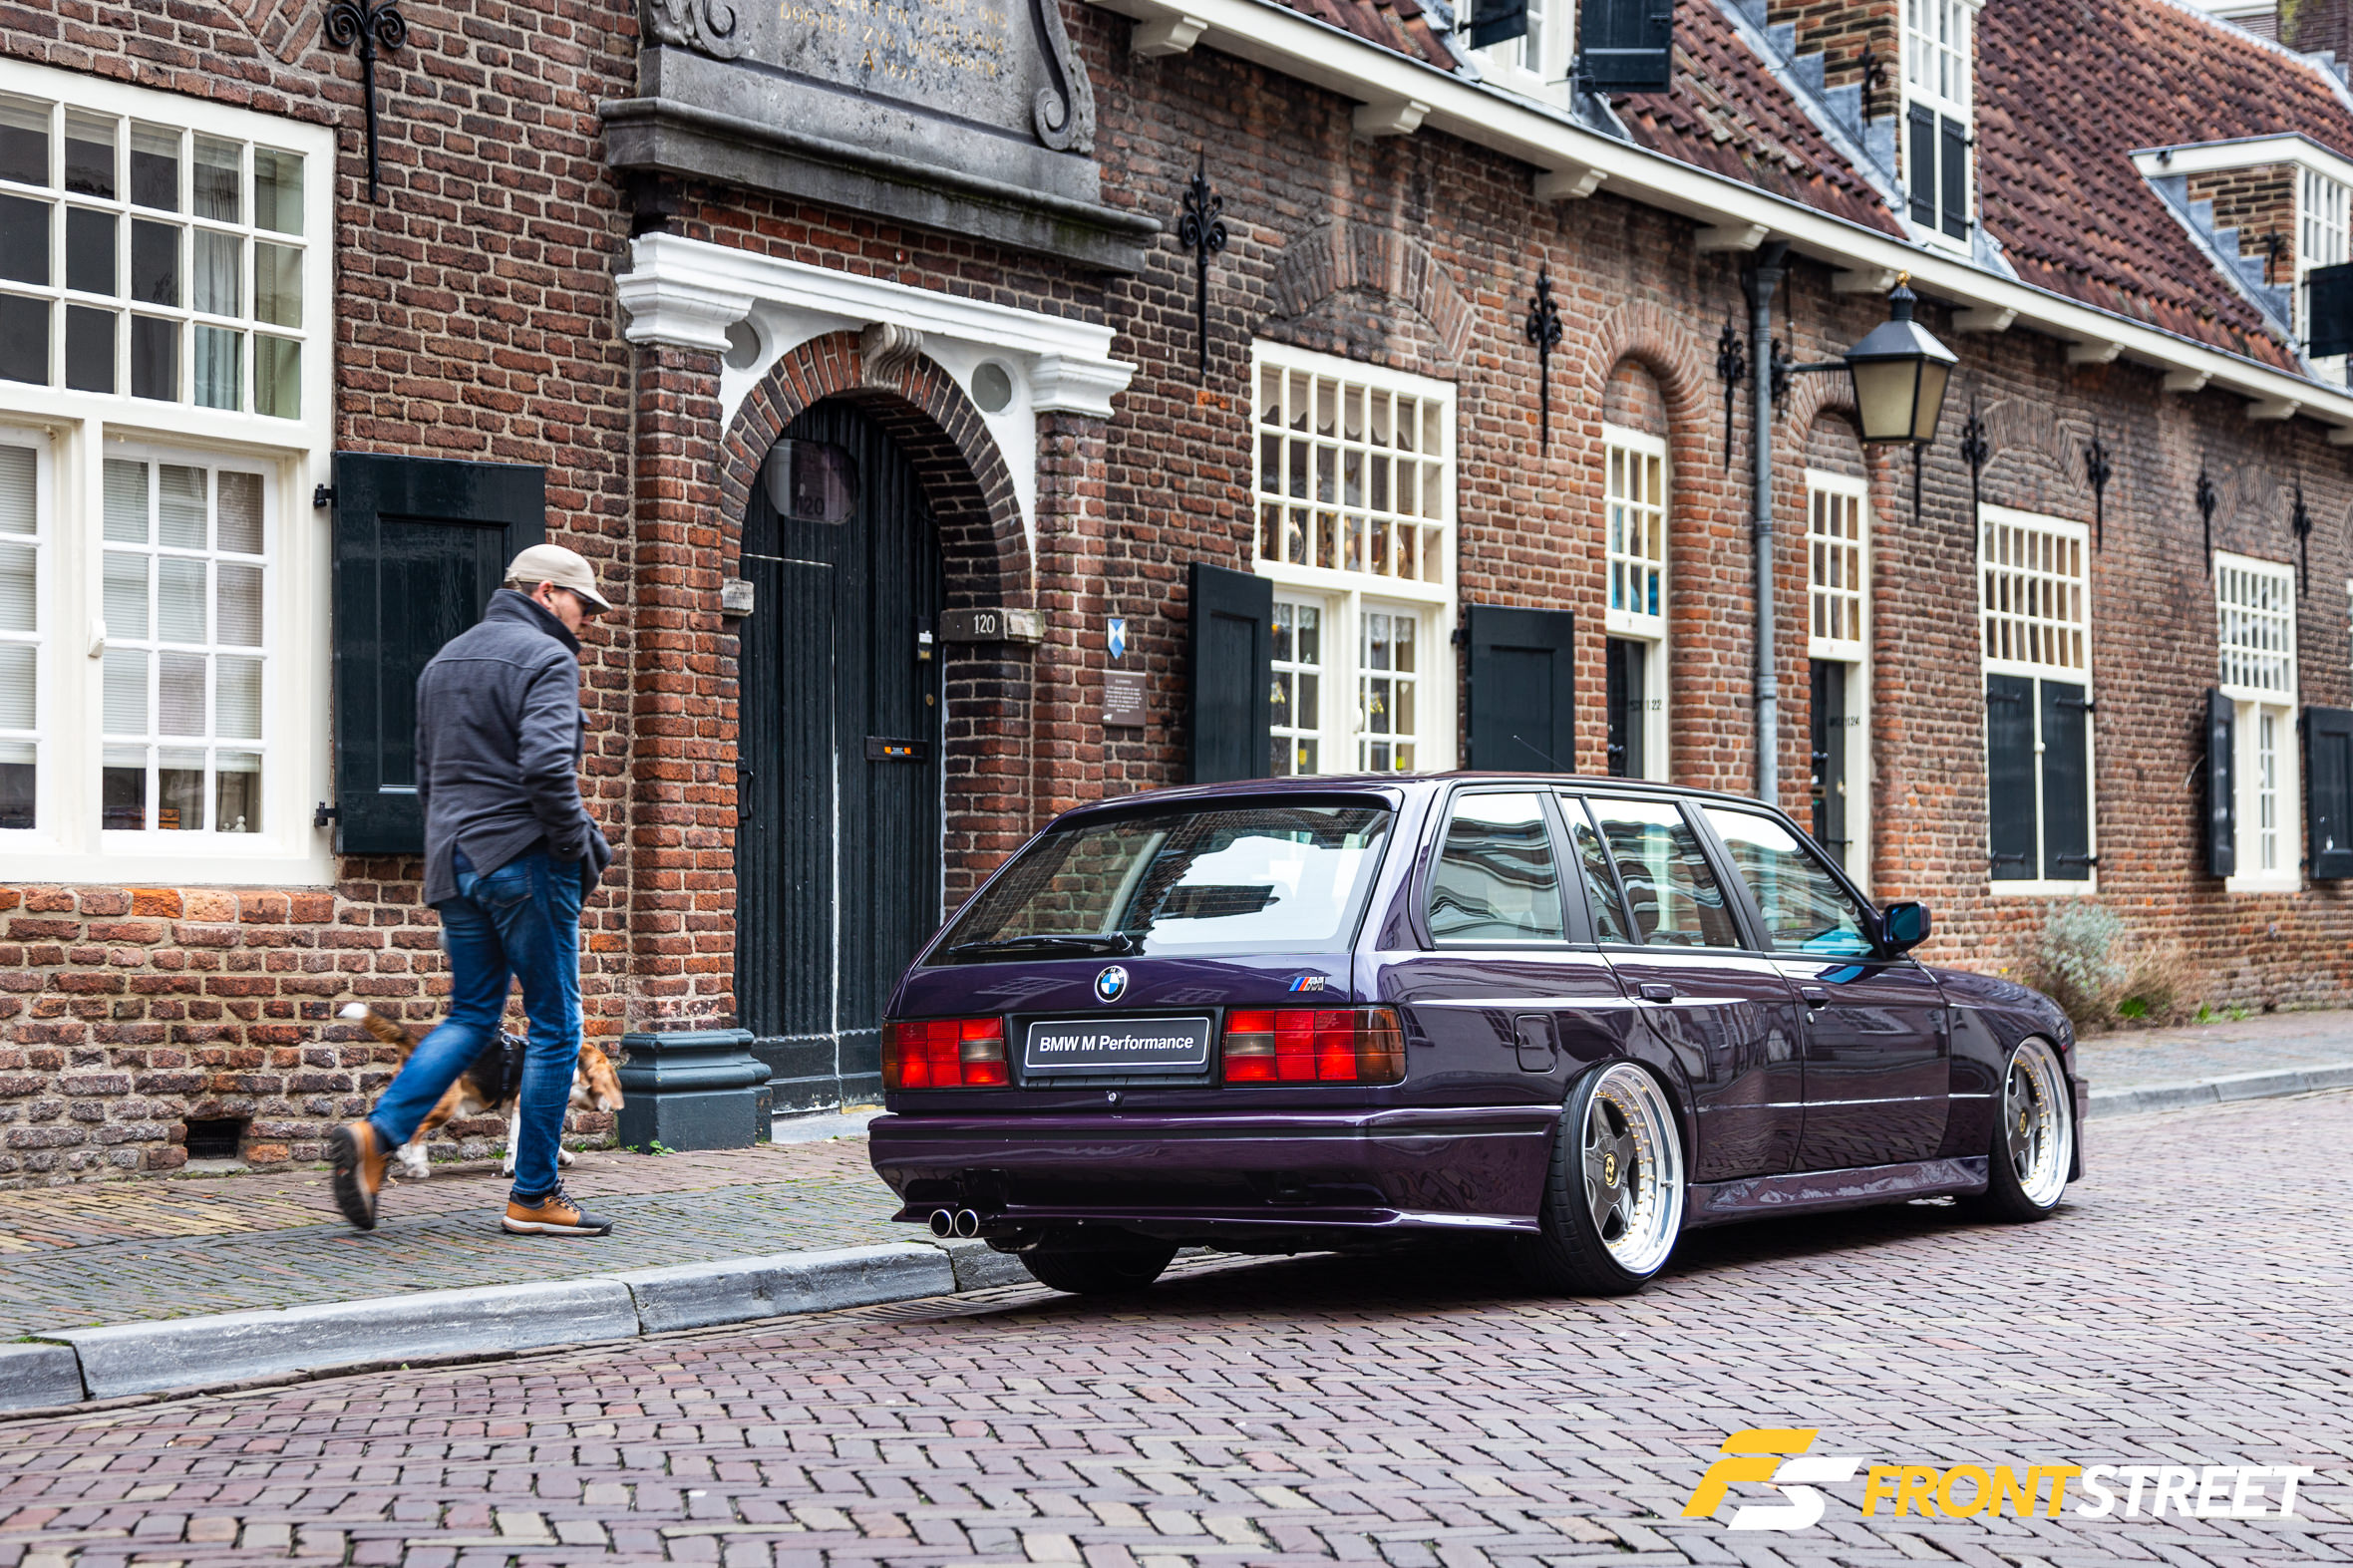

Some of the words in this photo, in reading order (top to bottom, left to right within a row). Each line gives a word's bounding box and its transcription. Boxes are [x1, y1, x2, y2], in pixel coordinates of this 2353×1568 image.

[780, 2, 847, 36] DOGTER
[973, 614, 996, 634] 120
[1039, 1036, 1079, 1053] BMW
[1081, 1036, 1096, 1051] M
[1099, 1034, 1194, 1051] Performance
